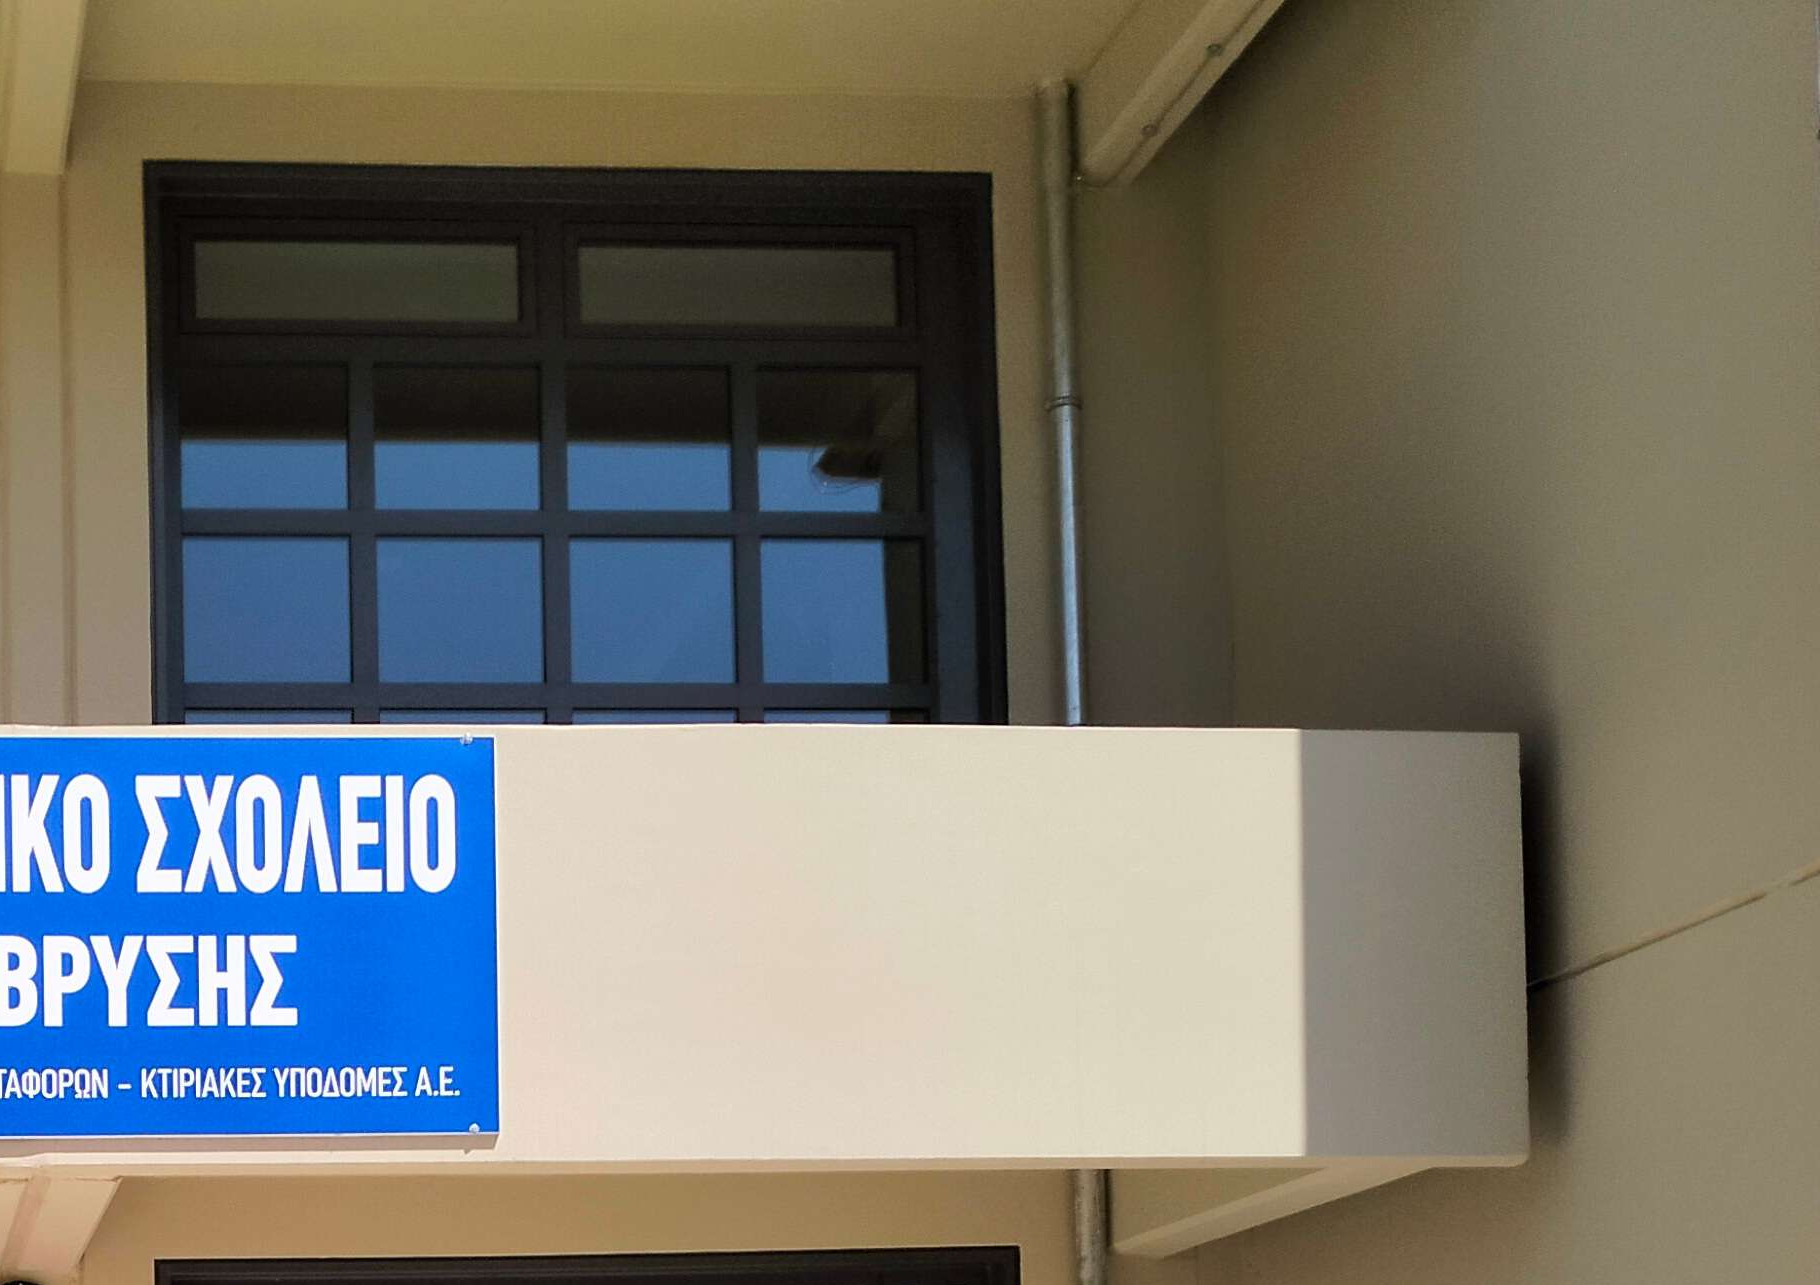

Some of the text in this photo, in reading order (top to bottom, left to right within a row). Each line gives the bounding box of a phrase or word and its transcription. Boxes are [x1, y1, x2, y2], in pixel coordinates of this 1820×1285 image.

[136, 773, 456, 893] ΣΧΟΛΕΙΟ
[141, 1067, 266, 1099] ΚΤΙΡΙΑΚΕΣ
[274, 1066, 407, 1098] ΥΠΟΔΟΜΕΣ
[415, 1066, 461, 1097] Α.Ε.
